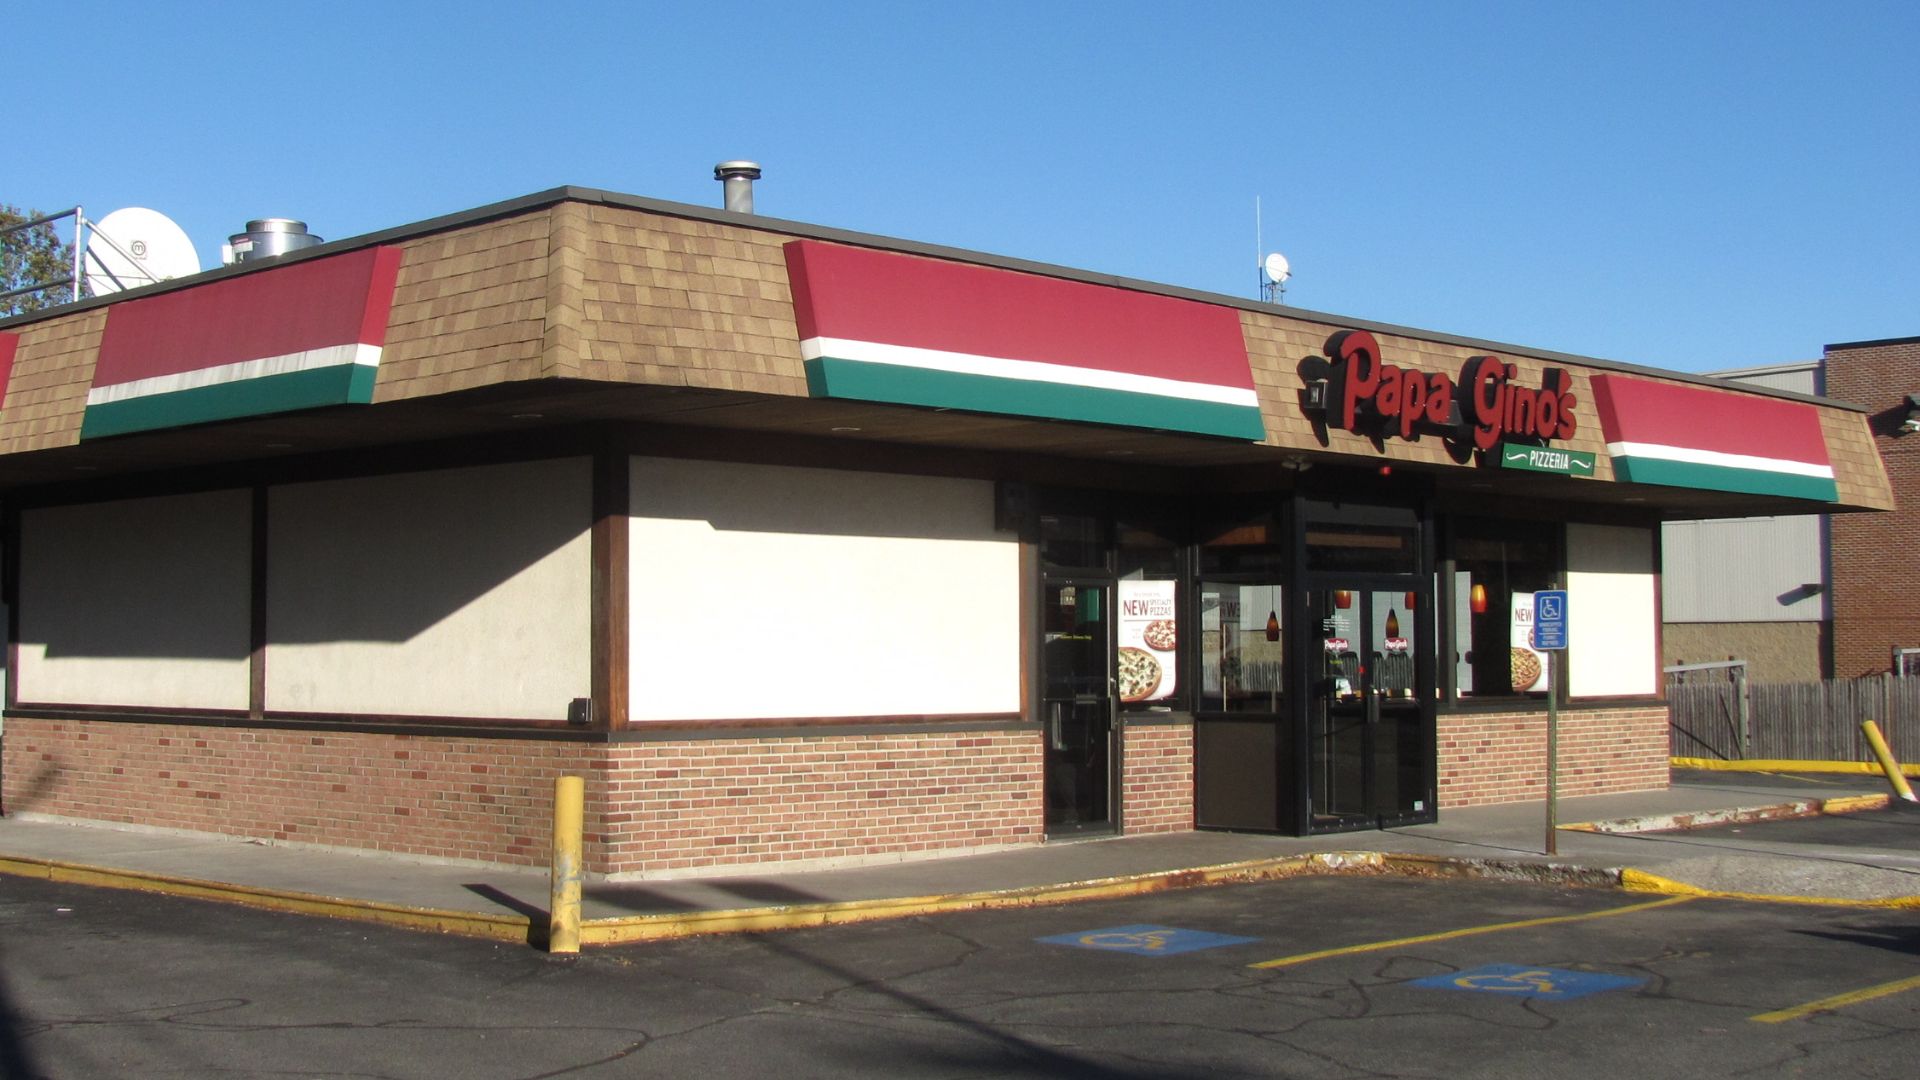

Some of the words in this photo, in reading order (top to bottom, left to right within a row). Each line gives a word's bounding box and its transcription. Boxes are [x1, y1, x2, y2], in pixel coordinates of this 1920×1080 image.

[1326, 329, 1451, 438] Papa
[1463, 355, 1578, 449] Gino's
[1529, 450, 1569, 470] PIZZERIA
[1123, 599, 1149, 617] NEW
[1149, 598, 1172, 606] SPECIALTY
[1149, 606, 1172, 616] PIZZAS
[1514, 608, 1534, 622] NEW
